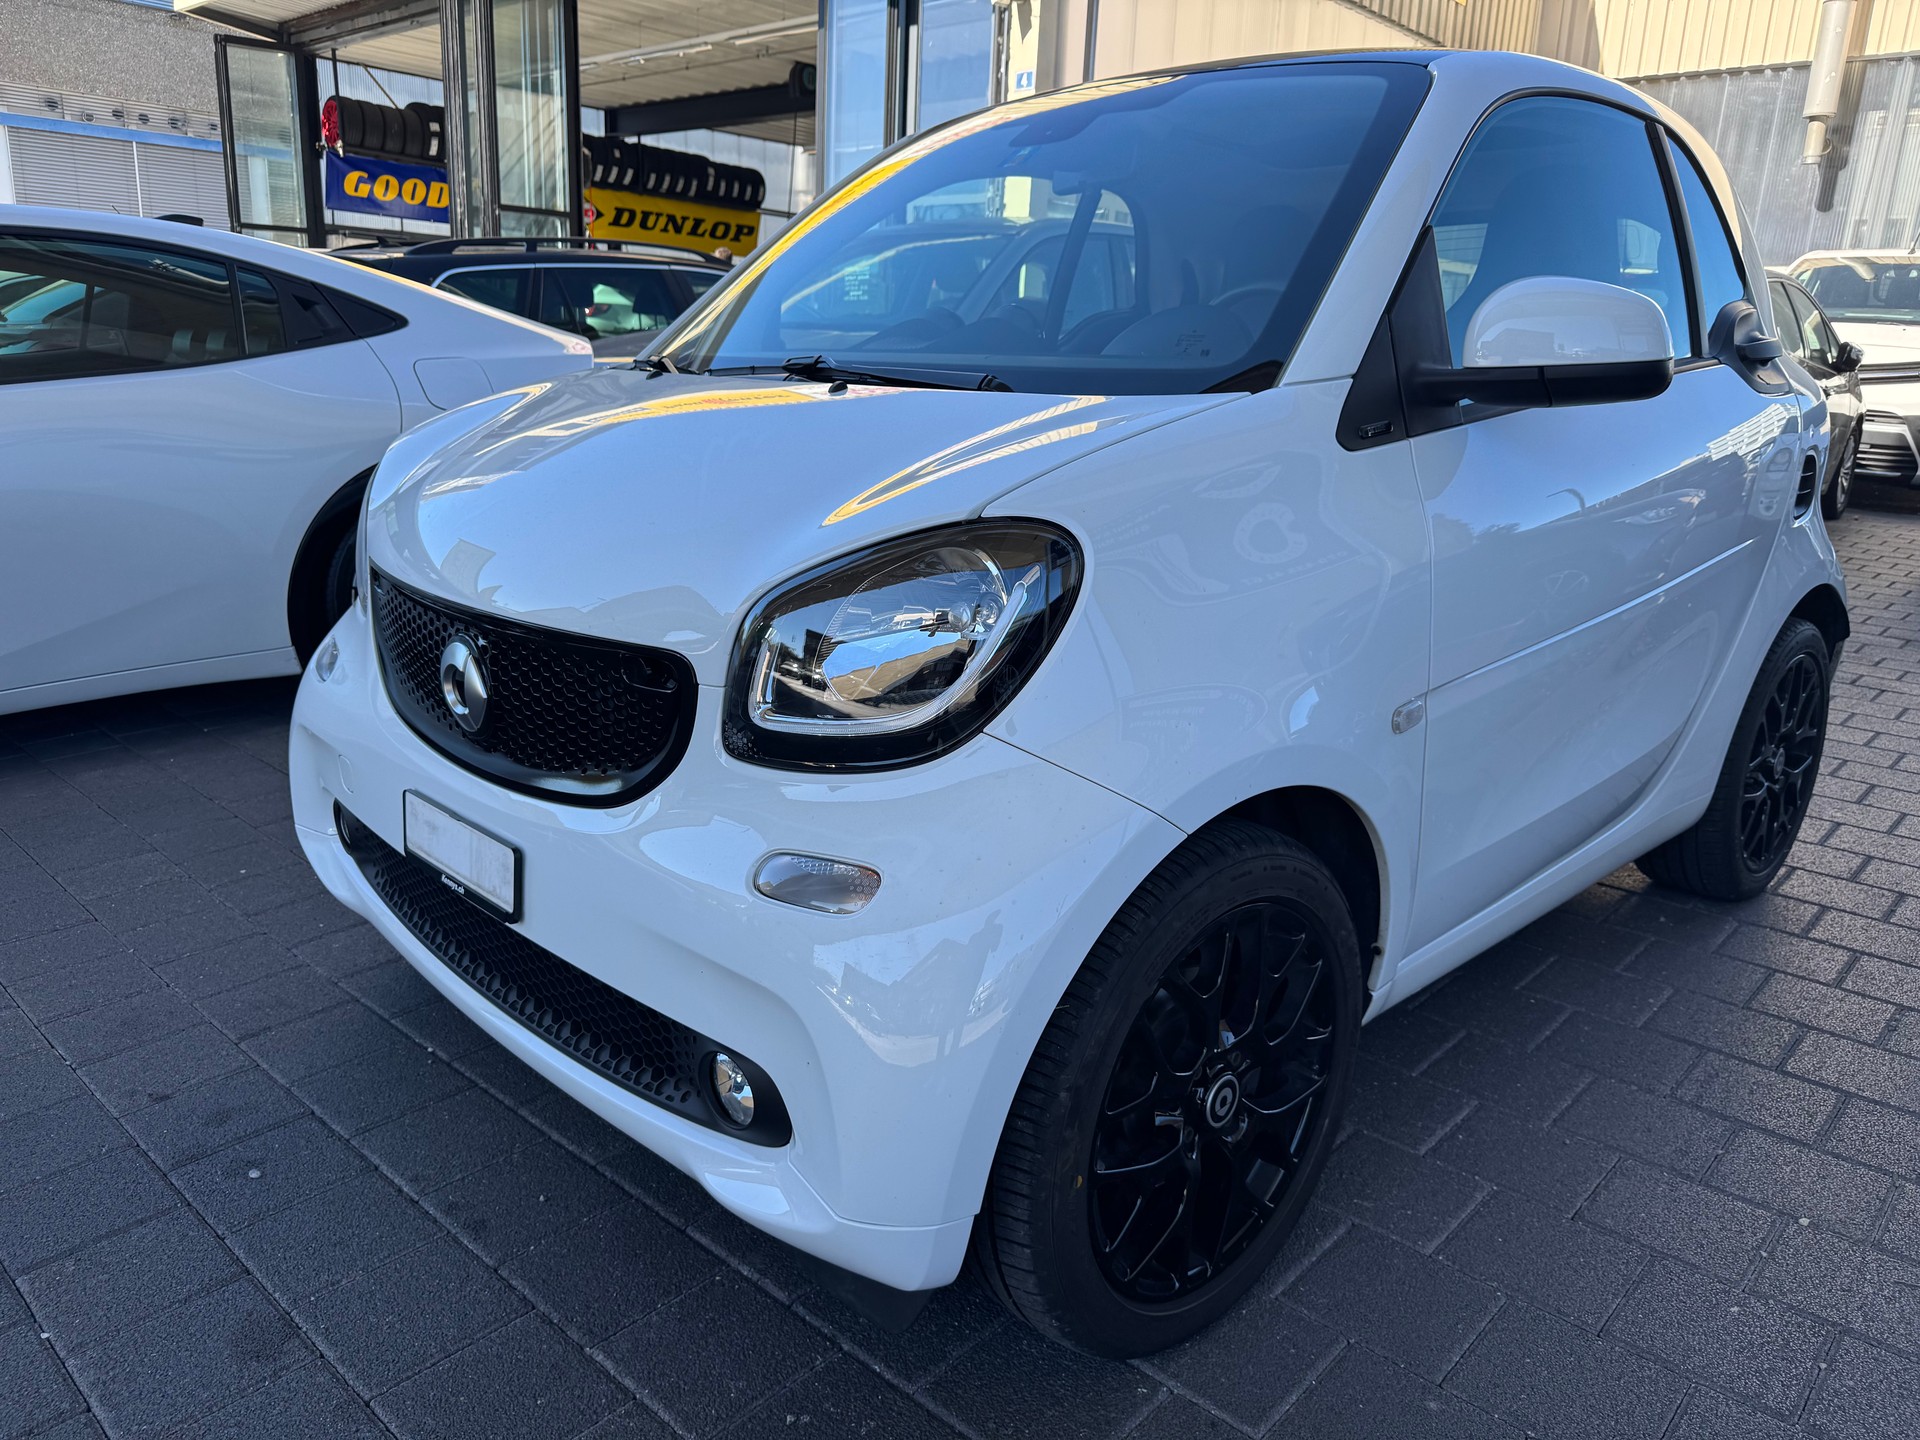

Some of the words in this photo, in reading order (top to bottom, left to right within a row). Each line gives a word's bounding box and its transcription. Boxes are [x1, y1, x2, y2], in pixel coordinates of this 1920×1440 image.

[1020, 72, 1028, 88] 4
[343, 170, 450, 209] GOOD
[608, 206, 756, 243] DUNLOP
[441, 873, 465, 895] Kennys.ch
